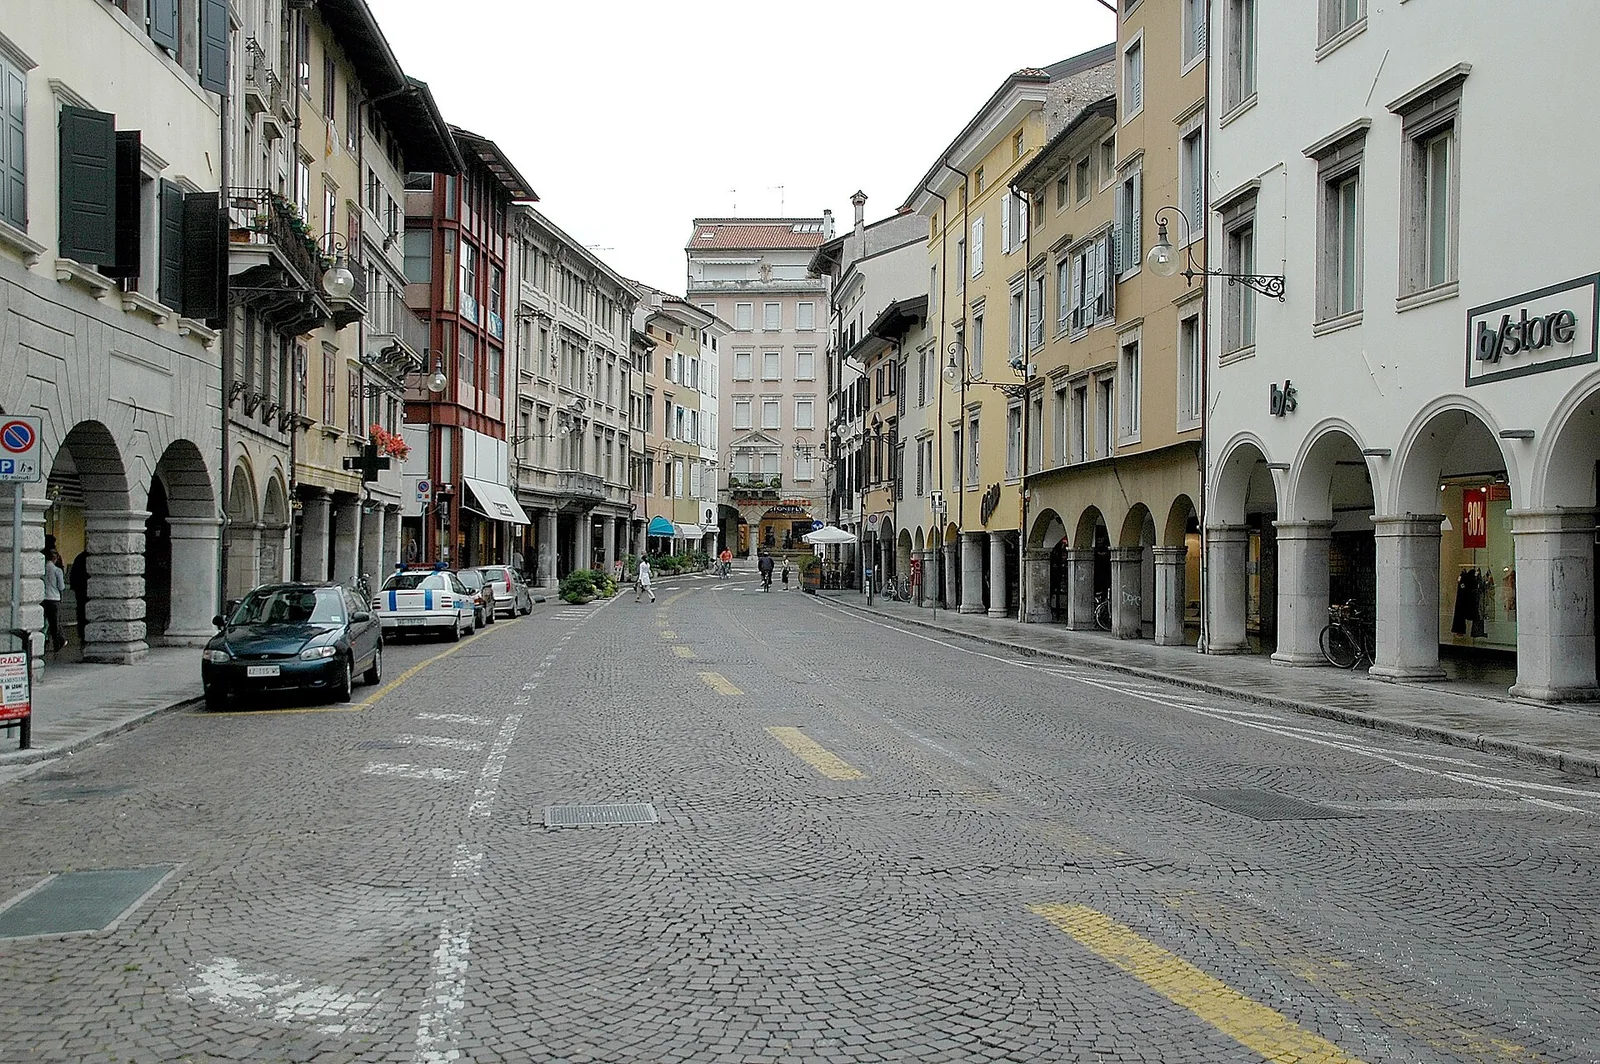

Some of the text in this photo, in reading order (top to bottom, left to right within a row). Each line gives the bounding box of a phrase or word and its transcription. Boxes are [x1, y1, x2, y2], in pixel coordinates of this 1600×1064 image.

[1476, 308, 1576, 364] b/store
[1270, 379, 1297, 417] b/s
[1, 461, 12, 472] P
[1464, 501, 1485, 536] -30%
